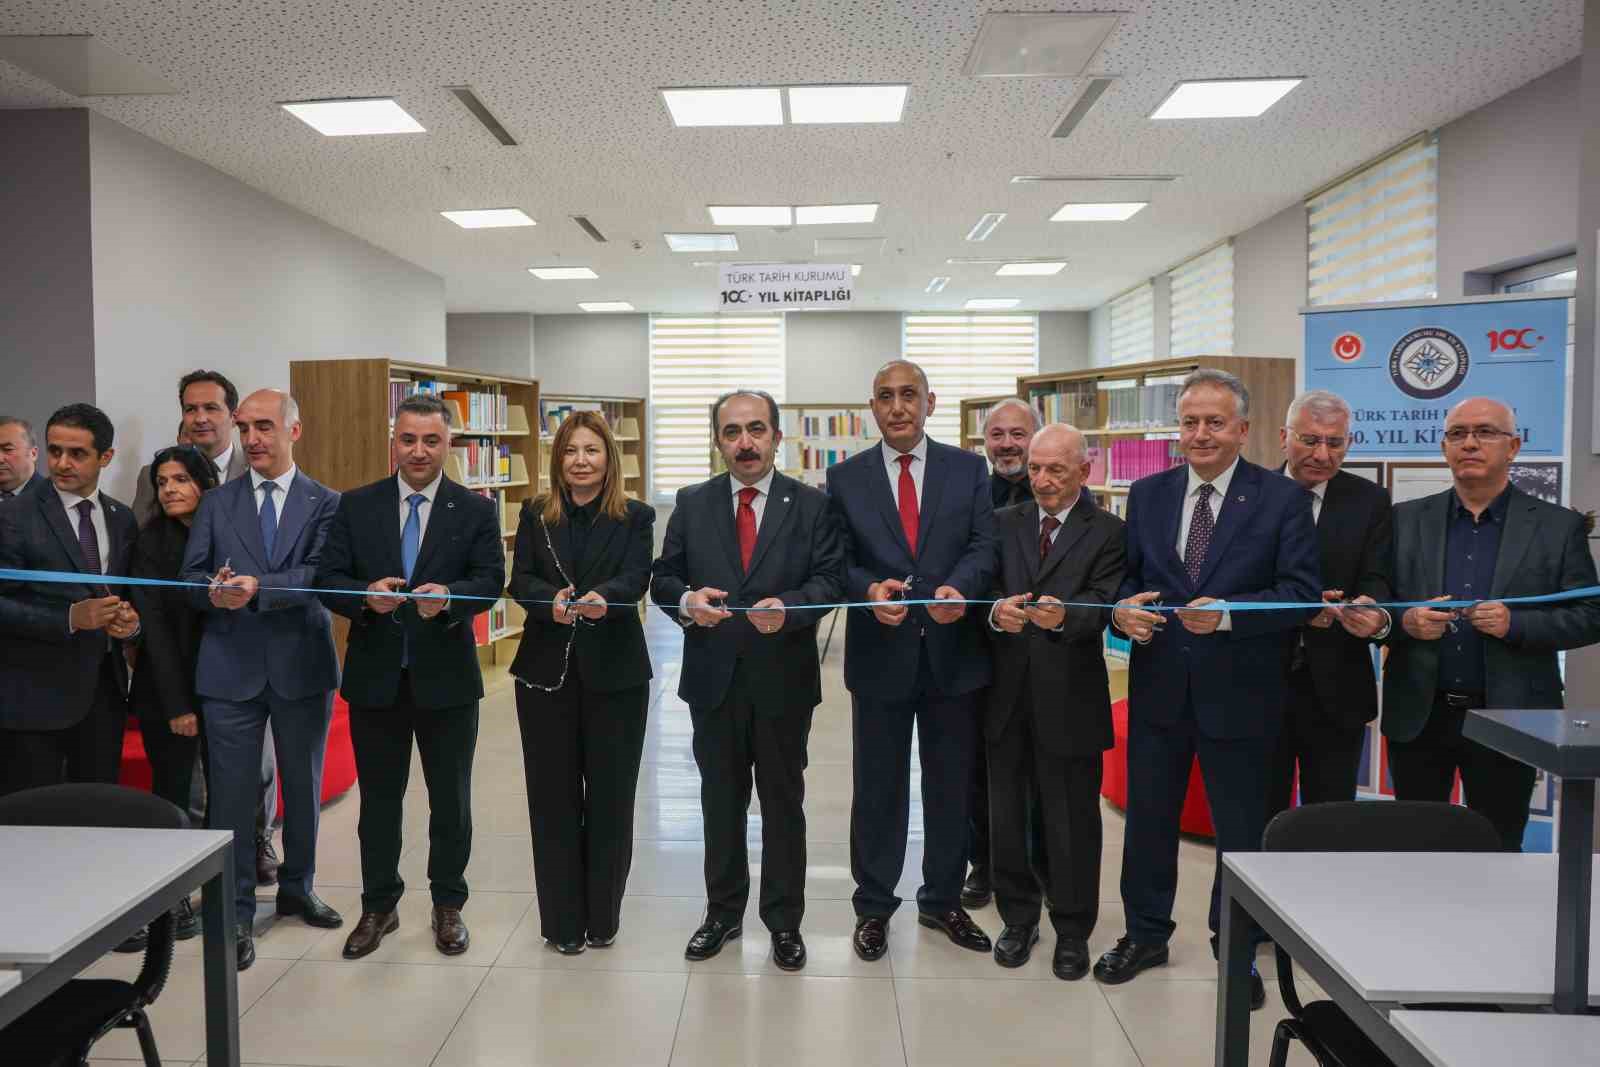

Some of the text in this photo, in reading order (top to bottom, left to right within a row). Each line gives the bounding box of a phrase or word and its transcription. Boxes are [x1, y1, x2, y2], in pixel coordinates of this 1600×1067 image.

[726, 270, 845, 284] TÜRK TARİH KURUMU
[758, 290, 780, 303] YIL
[783, 287, 851, 302] KİTAPLIĞI
[1390, 407, 1439, 421] TARİH
[1375, 430, 1409, 444] YIL
